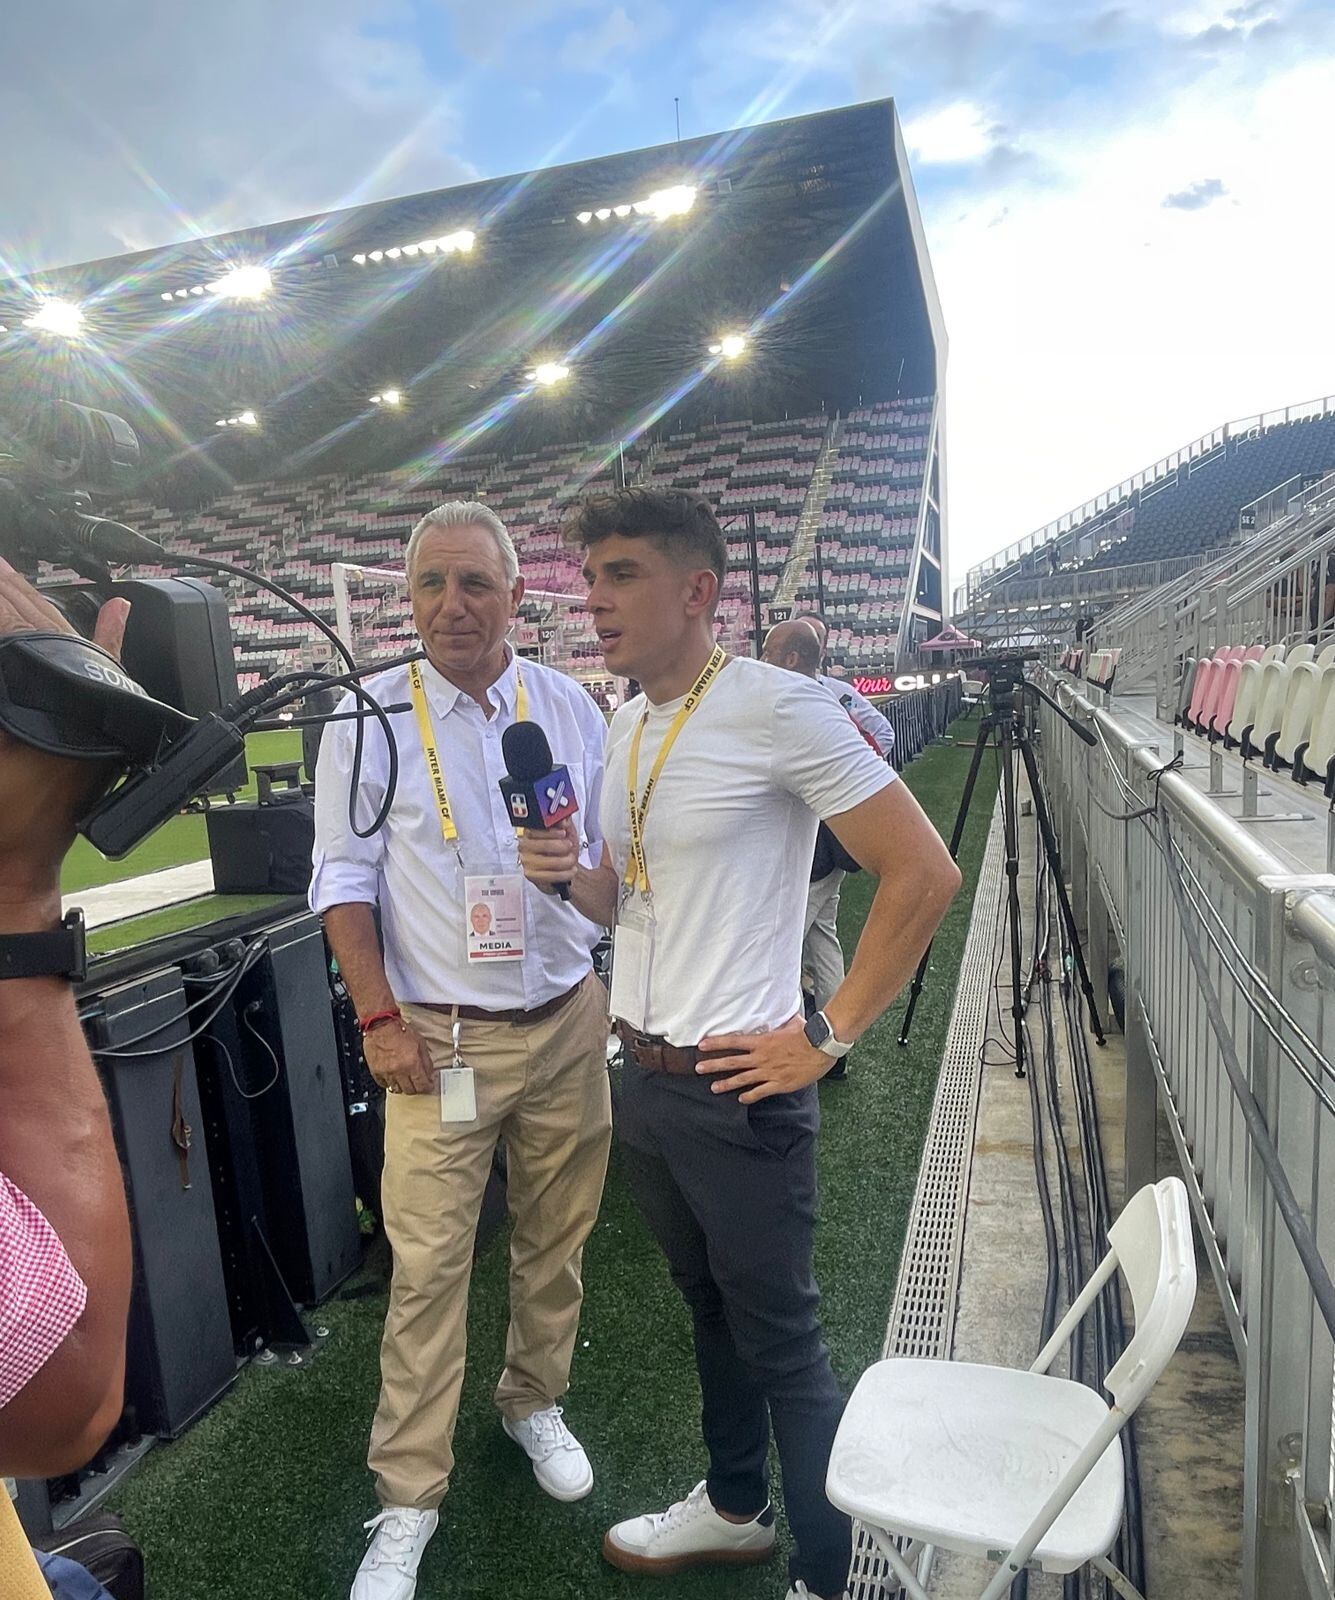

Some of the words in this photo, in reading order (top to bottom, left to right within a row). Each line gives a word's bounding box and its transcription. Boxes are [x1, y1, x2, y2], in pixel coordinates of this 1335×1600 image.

[773, 611, 787, 620] 121
[542, 630, 555, 639] 120
[710, 649, 723, 668] TER
[84, 660, 148, 697] SON
[413, 679, 421, 689] CF
[691, 667, 714, 697] MIAMI
[853, 677, 892, 692] Your
[684, 697, 695, 711] CF
[427, 747, 440, 775] INTER
[434, 777, 447, 805] MIAMI
[441, 807, 451, 819] CF
[641, 778, 654, 810] INTER
[630, 806, 638, 838] MIAMI
[479, 941, 512, 950] MEDIA
